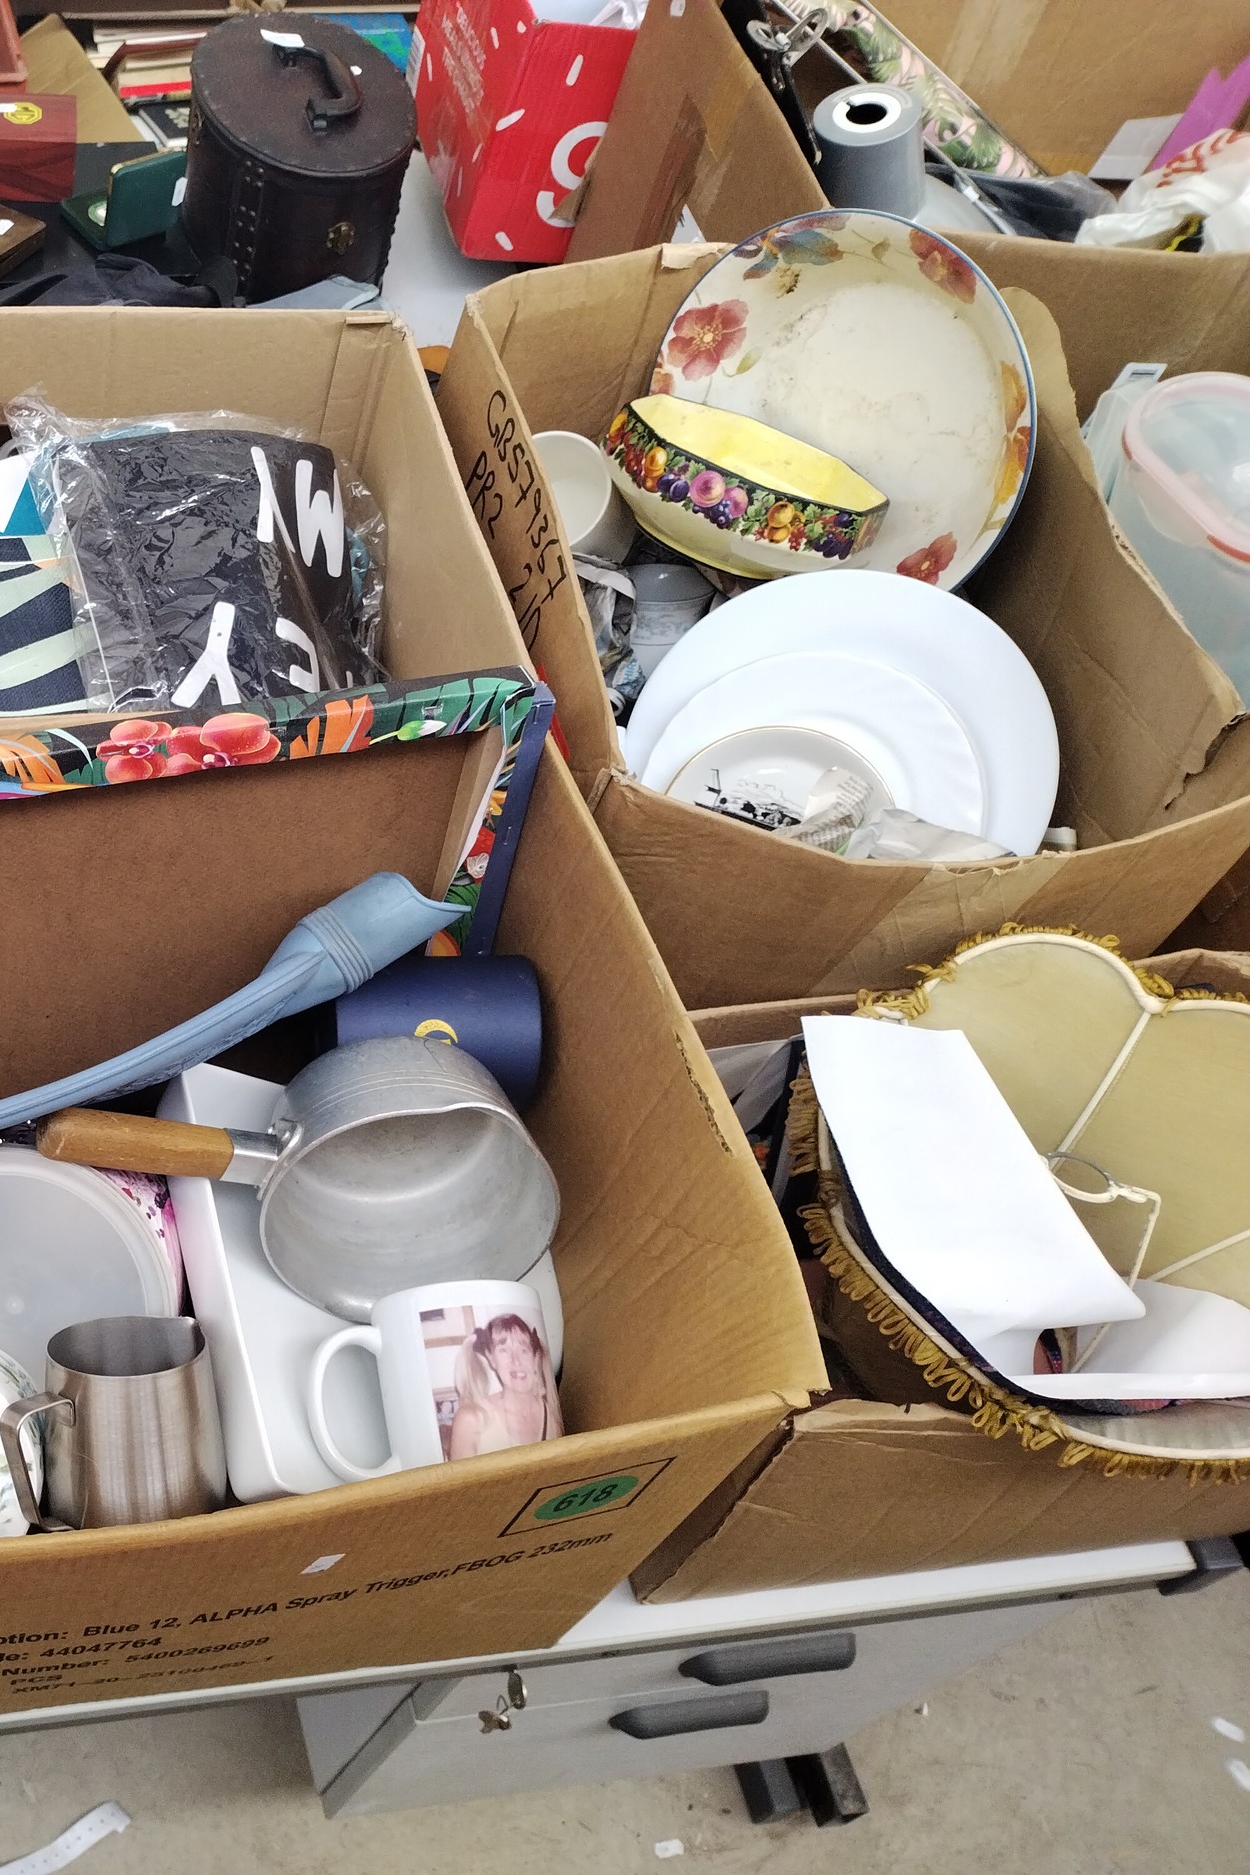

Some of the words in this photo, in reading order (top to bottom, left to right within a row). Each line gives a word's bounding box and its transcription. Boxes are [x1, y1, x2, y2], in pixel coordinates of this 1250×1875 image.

[553, 1483, 618, 1514] 618
[82, 1623, 140, 1638] Blue
[149, 1617, 183, 1630] 12,
[189, 1602, 278, 1625] ALPHA
[285, 1588, 357, 1611] Spray
[527, 1532, 613, 1559] 232mm
[39, 1636, 162, 1658] 44047764
[1, 1657, 110, 1677] Number:
[10, 1673, 63, 1686] PCS
